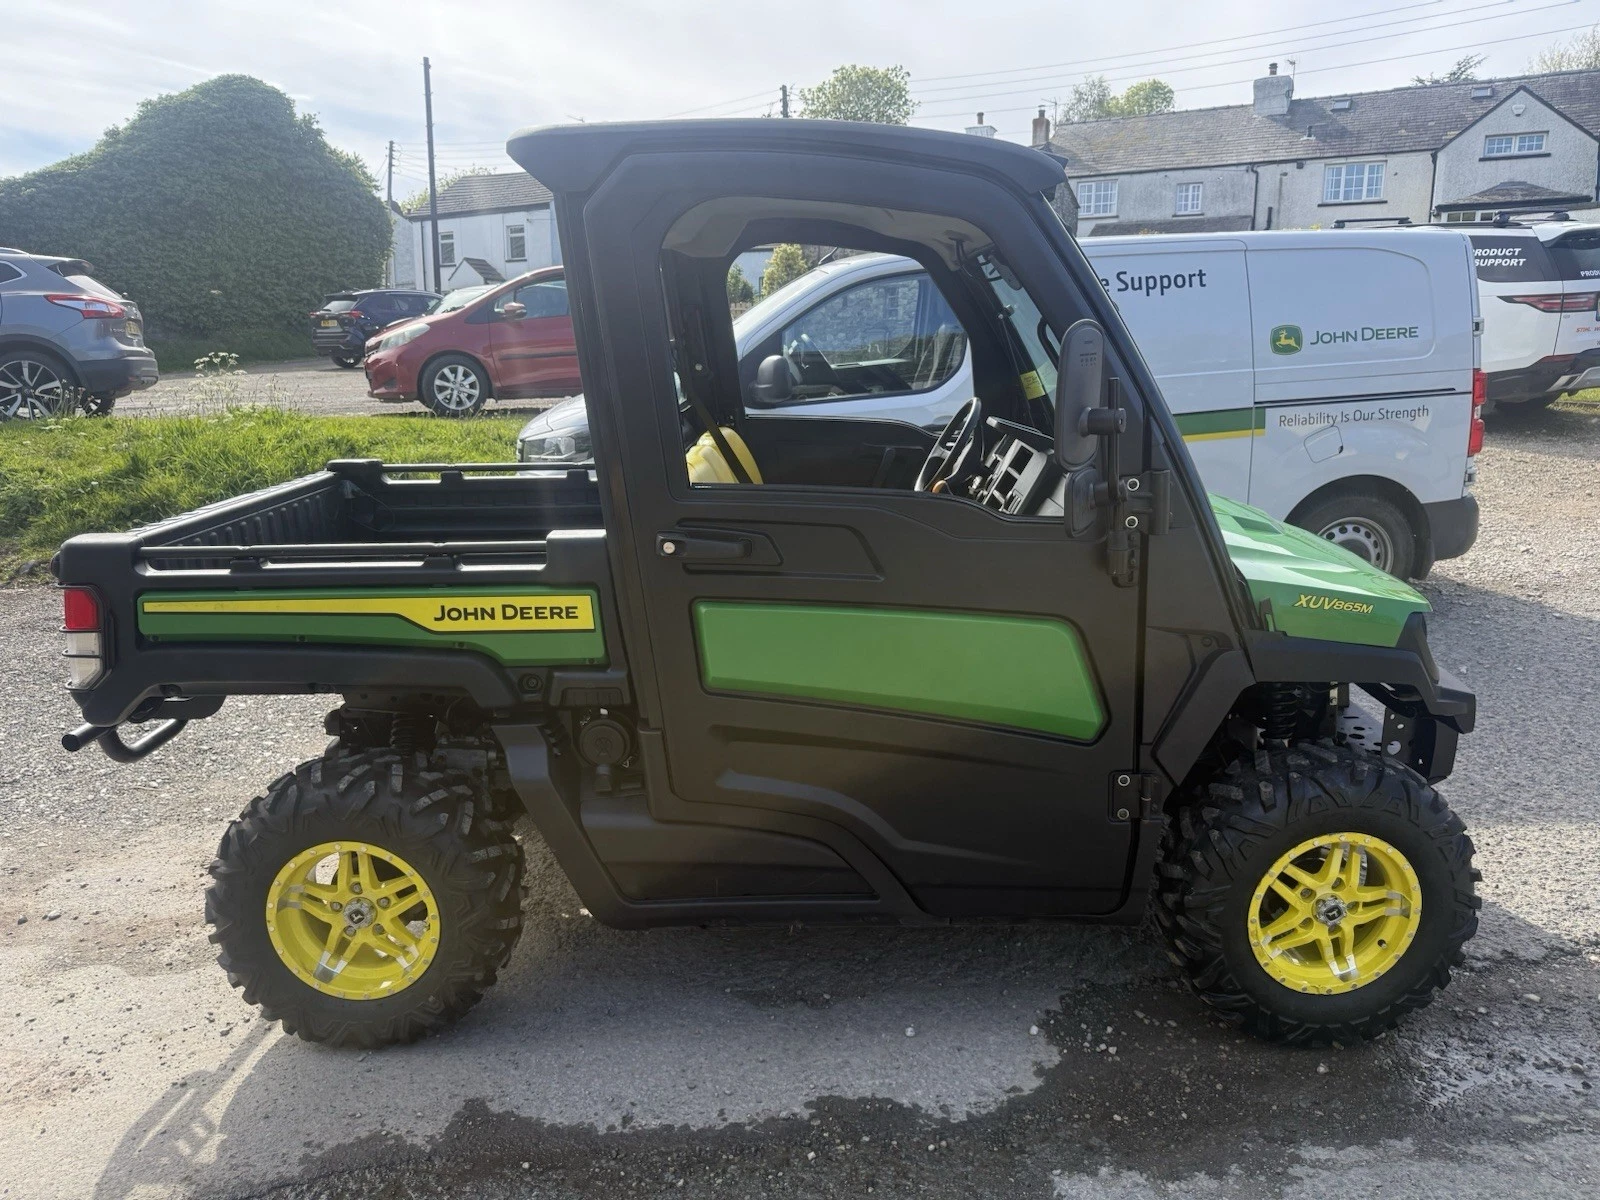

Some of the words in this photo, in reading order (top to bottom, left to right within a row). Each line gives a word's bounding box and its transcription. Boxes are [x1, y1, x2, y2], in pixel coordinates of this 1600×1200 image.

[1473, 248, 1522, 257] RODUCT
[1474, 258, 1527, 267] SUPPORT
[1115, 269, 1207, 297] Support
[1310, 330, 1358, 345] JOHN
[1361, 326, 1419, 341] DEERE
[1278, 412, 1338, 428] Reliability
[1340, 411, 1350, 423] Is
[1353, 409, 1375, 422] Our
[1378, 405, 1430, 422] Strength
[433, 604, 496, 621] JOHN
[501, 604, 579, 620] DEERE
[1294, 594, 1374, 614] XUV865M
